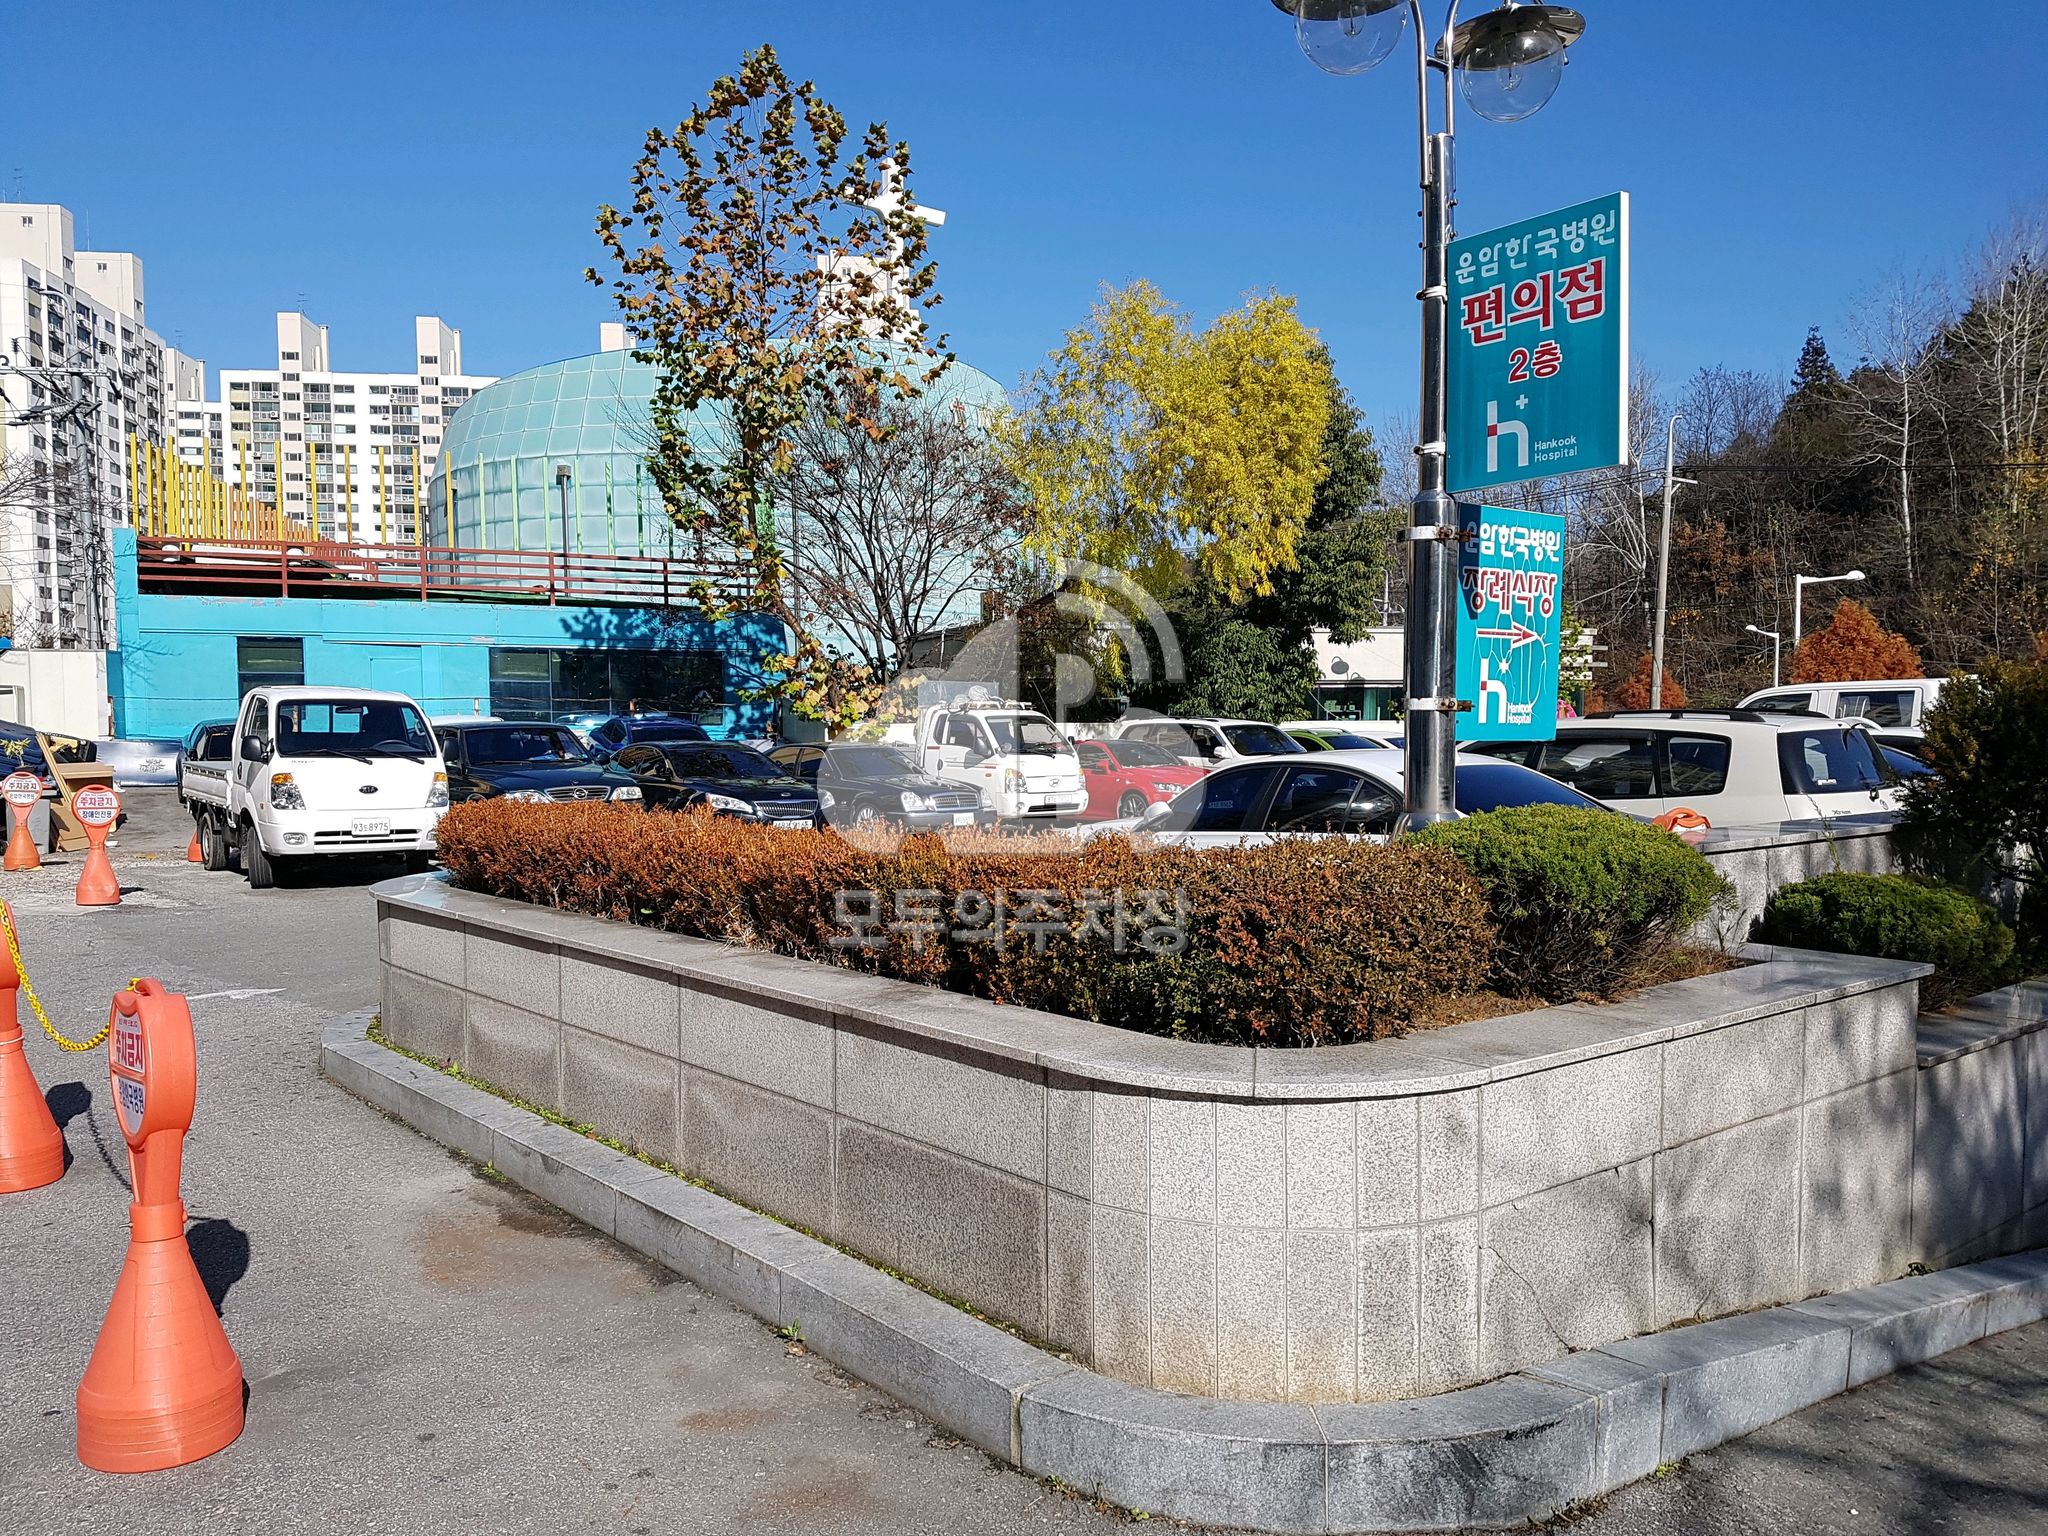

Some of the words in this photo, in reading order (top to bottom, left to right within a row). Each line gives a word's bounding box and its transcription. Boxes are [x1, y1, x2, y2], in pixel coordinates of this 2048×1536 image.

[1455, 210, 1615, 284] 운암한국병원
[1461, 256, 1606, 347] 편의점
[1508, 340, 1563, 384] 2층
[1534, 435, 1577, 451] Hankook
[1534, 446, 1578, 463] Hospital
[1465, 521, 1561, 562] 운암한국병원
[1463, 566, 1558, 617] 장례식장
[79, 796, 113, 806] 주차금지
